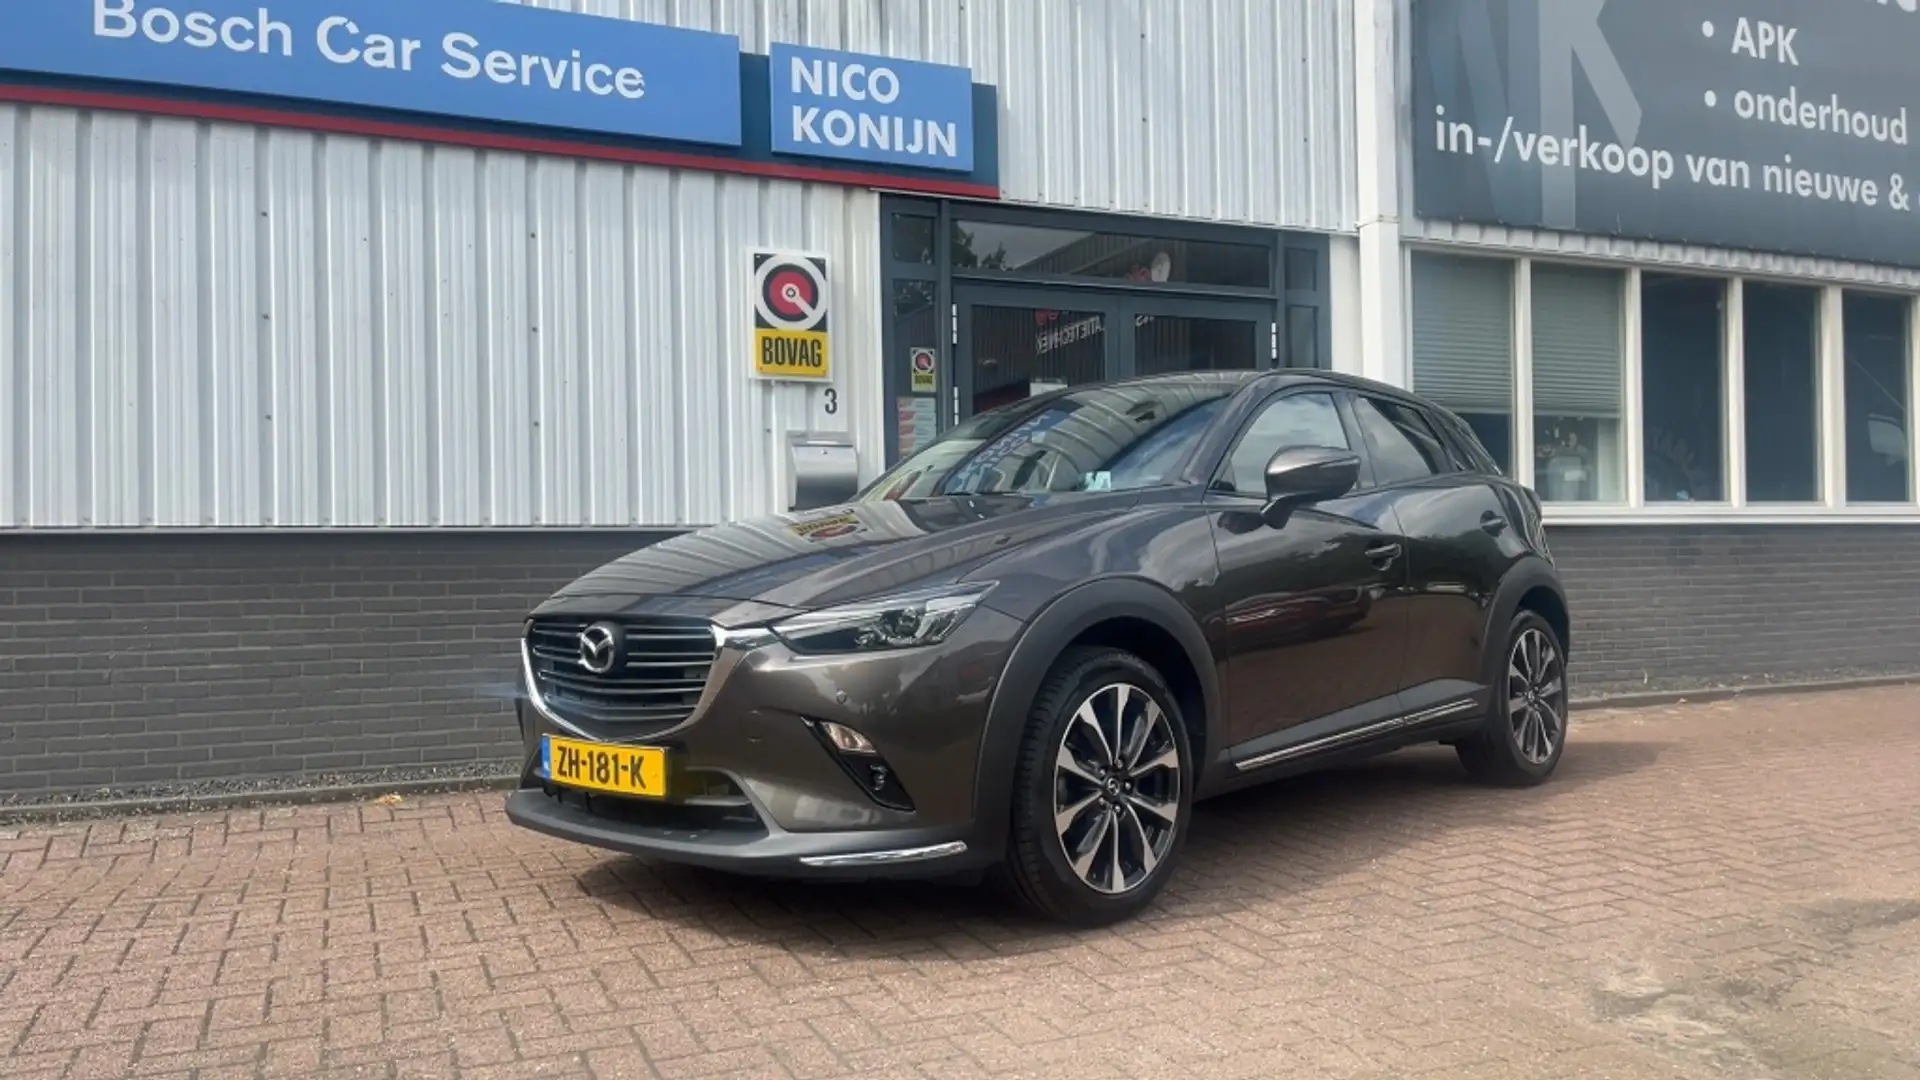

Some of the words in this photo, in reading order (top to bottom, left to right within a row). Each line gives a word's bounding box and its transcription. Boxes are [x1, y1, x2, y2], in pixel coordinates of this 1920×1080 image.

[94, 0, 292, 56] Bosch
[316, 15, 421, 70] Car
[441, 32, 645, 98] Service
[1731, 17, 1799, 66] APK
[791, 56, 899, 104] NICO
[792, 105, 957, 157] KONIJN
[1734, 86, 1908, 145] onderhoud
[1436, 105, 1674, 189] in-/verkoop
[1685, 154, 1750, 189] van
[1763, 154, 1879, 206] nieuwe
[1888, 173, 1911, 211] &
[761, 336, 822, 368] BOVAG
[824, 388, 838, 414] 3
[557, 745, 647, 789] ZH-181-K
